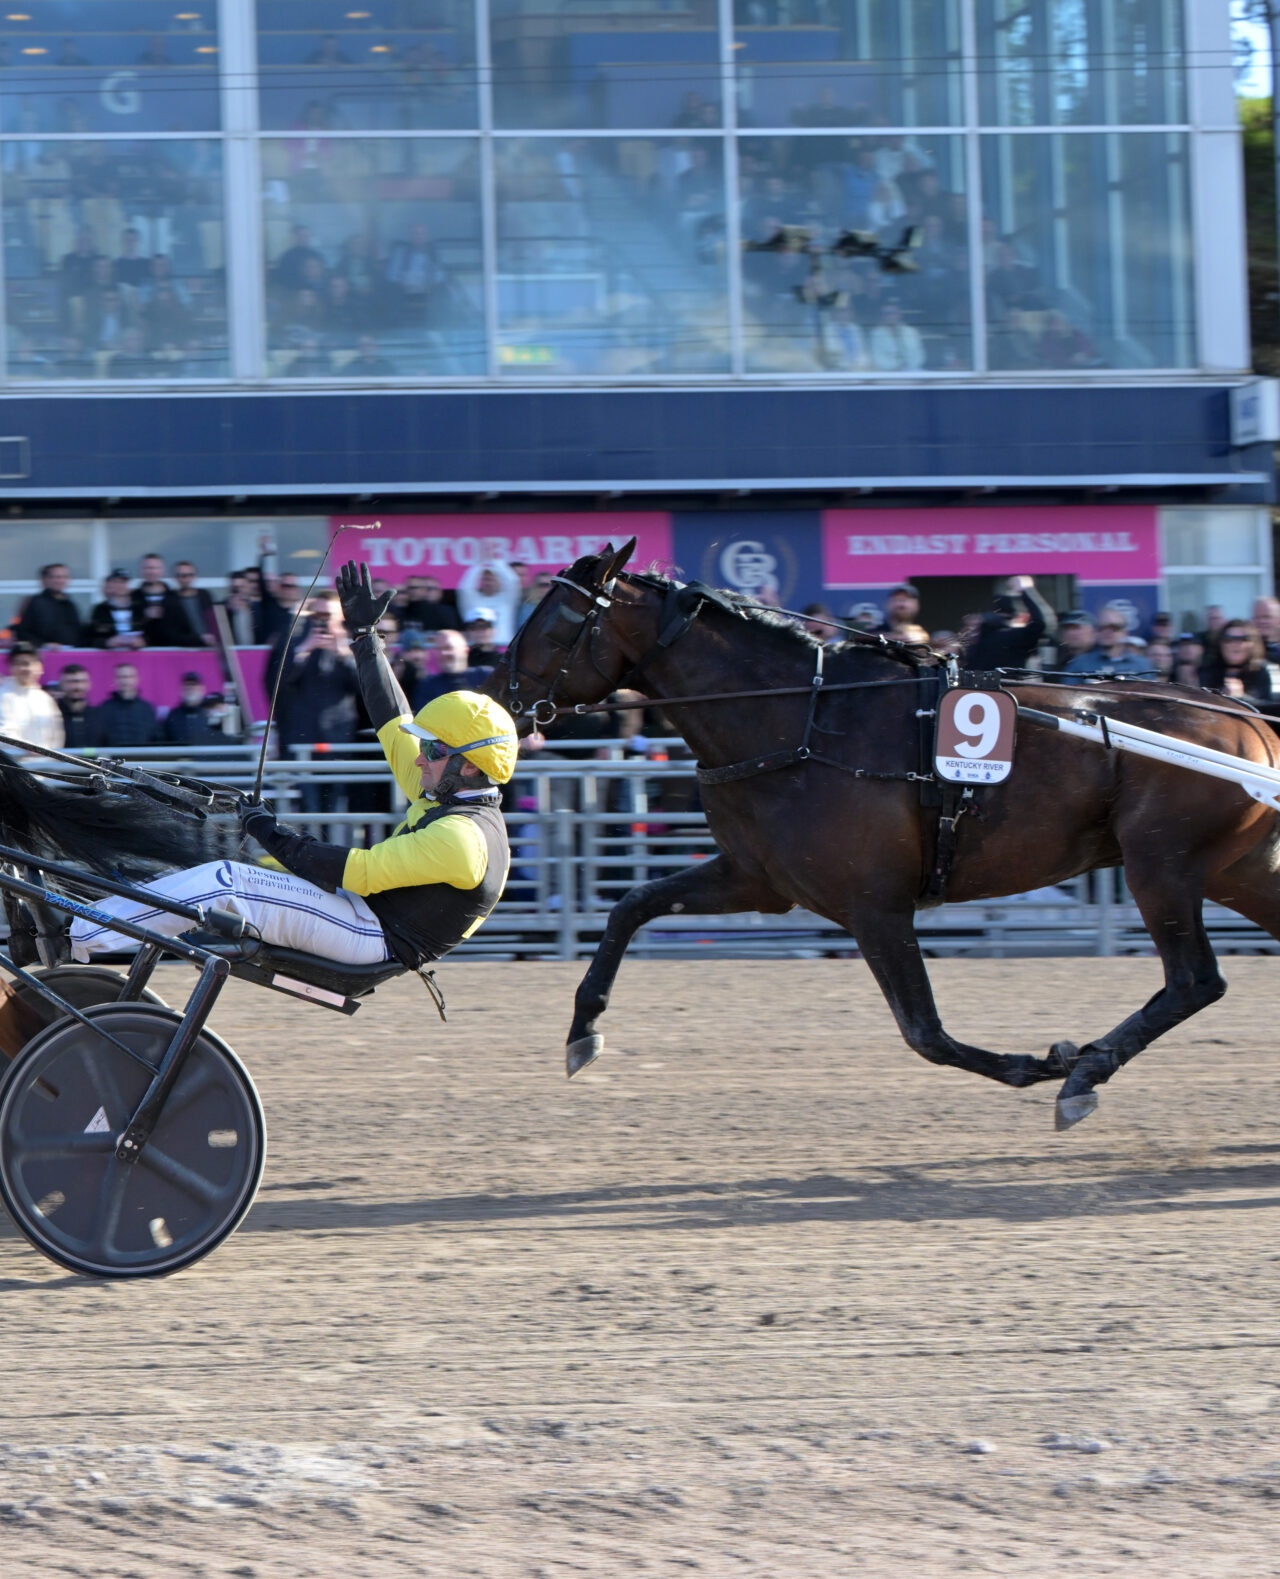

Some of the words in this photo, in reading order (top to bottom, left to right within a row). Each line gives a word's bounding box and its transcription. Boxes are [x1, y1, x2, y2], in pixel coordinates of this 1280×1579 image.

[100, 71, 141, 115] G
[847, 533, 968, 555] ENDAST
[974, 531, 1139, 553] PERSONAL
[953, 692, 1000, 759] 9
[945, 760, 982, 770] KENTUCKY
[983, 763, 1004, 772] RIVER
[247, 876, 324, 900] caravancenter
[45, 891, 113, 923] YANKEE
